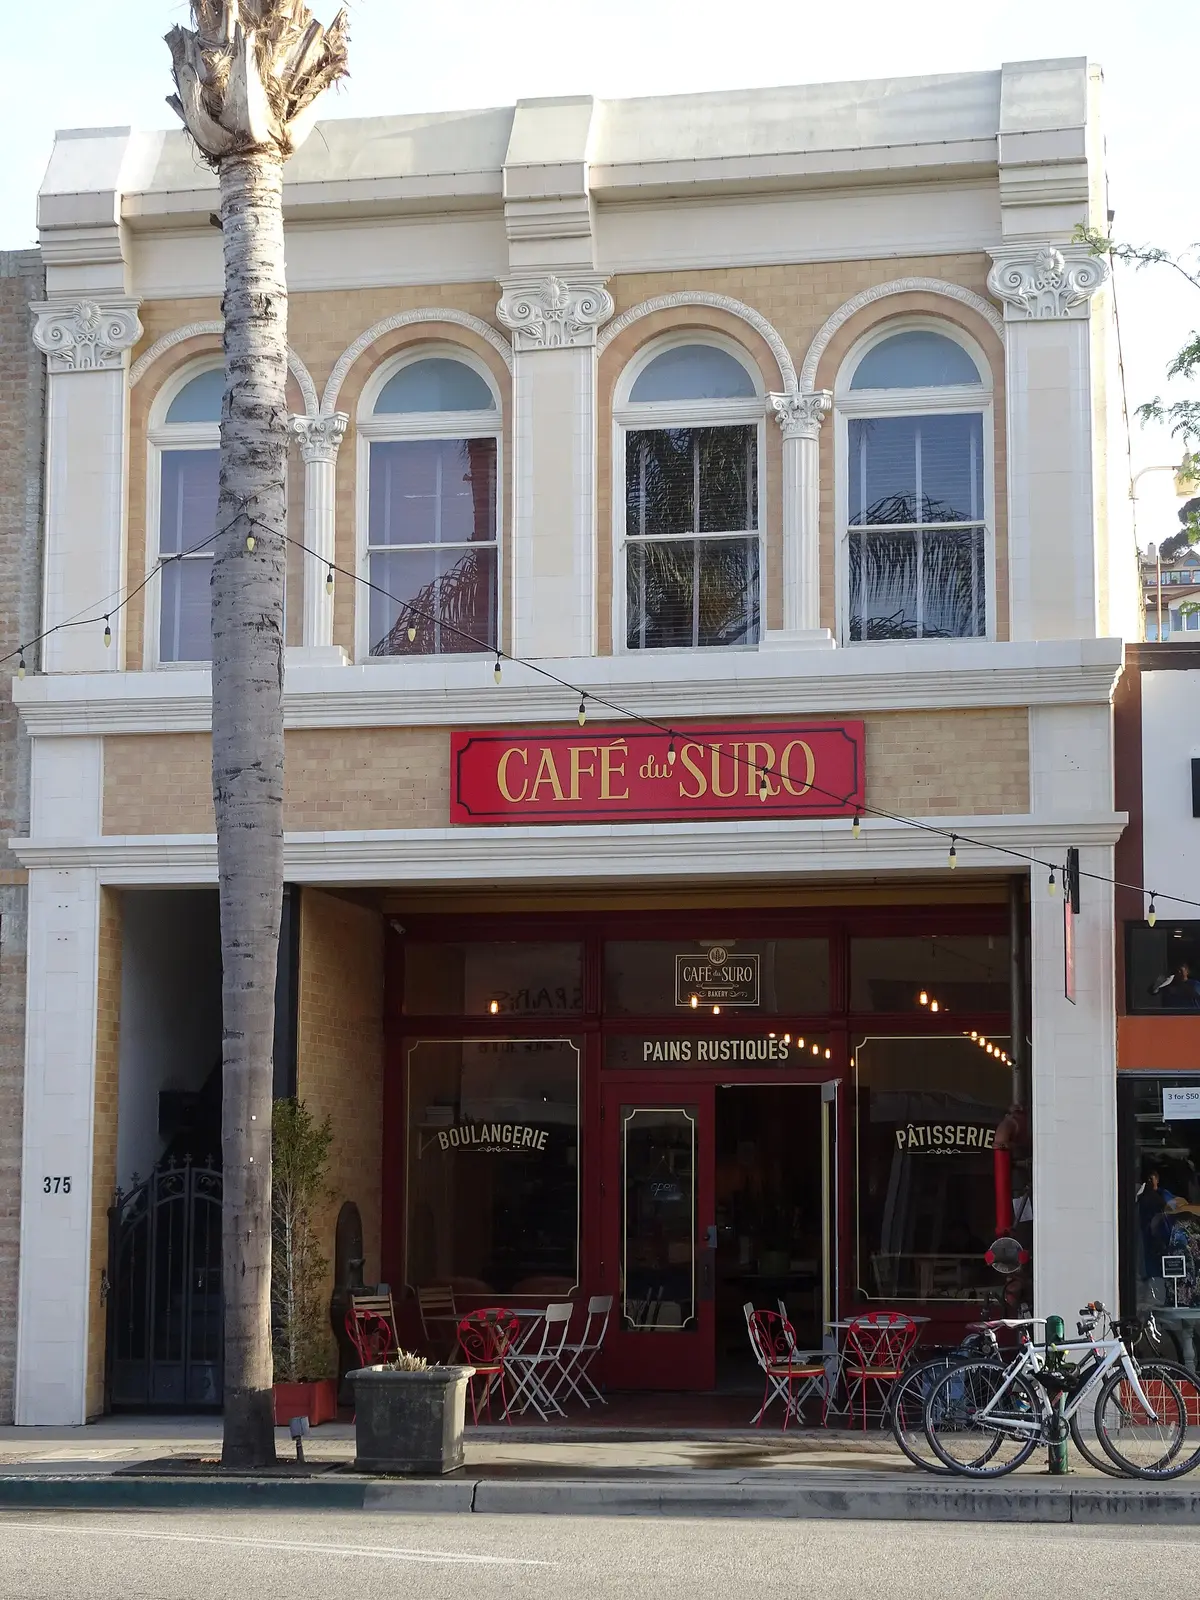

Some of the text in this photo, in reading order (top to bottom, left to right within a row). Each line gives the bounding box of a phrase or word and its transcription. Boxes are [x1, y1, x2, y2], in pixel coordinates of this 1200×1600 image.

[496, 737, 817, 803] CAFÉ du SURO
[683, 965, 713, 982] CAFÉ
[721, 966, 753, 982] SURO
[707, 990, 728, 998] BAKERY
[643, 1041, 692, 1061] PAINS
[697, 1040, 789, 1061] RUSTIQUES
[437, 1123, 549, 1151] BOULANGERIE
[895, 1123, 996, 1150] PÂTISSERIE
[43, 1176, 72, 1194] 375
